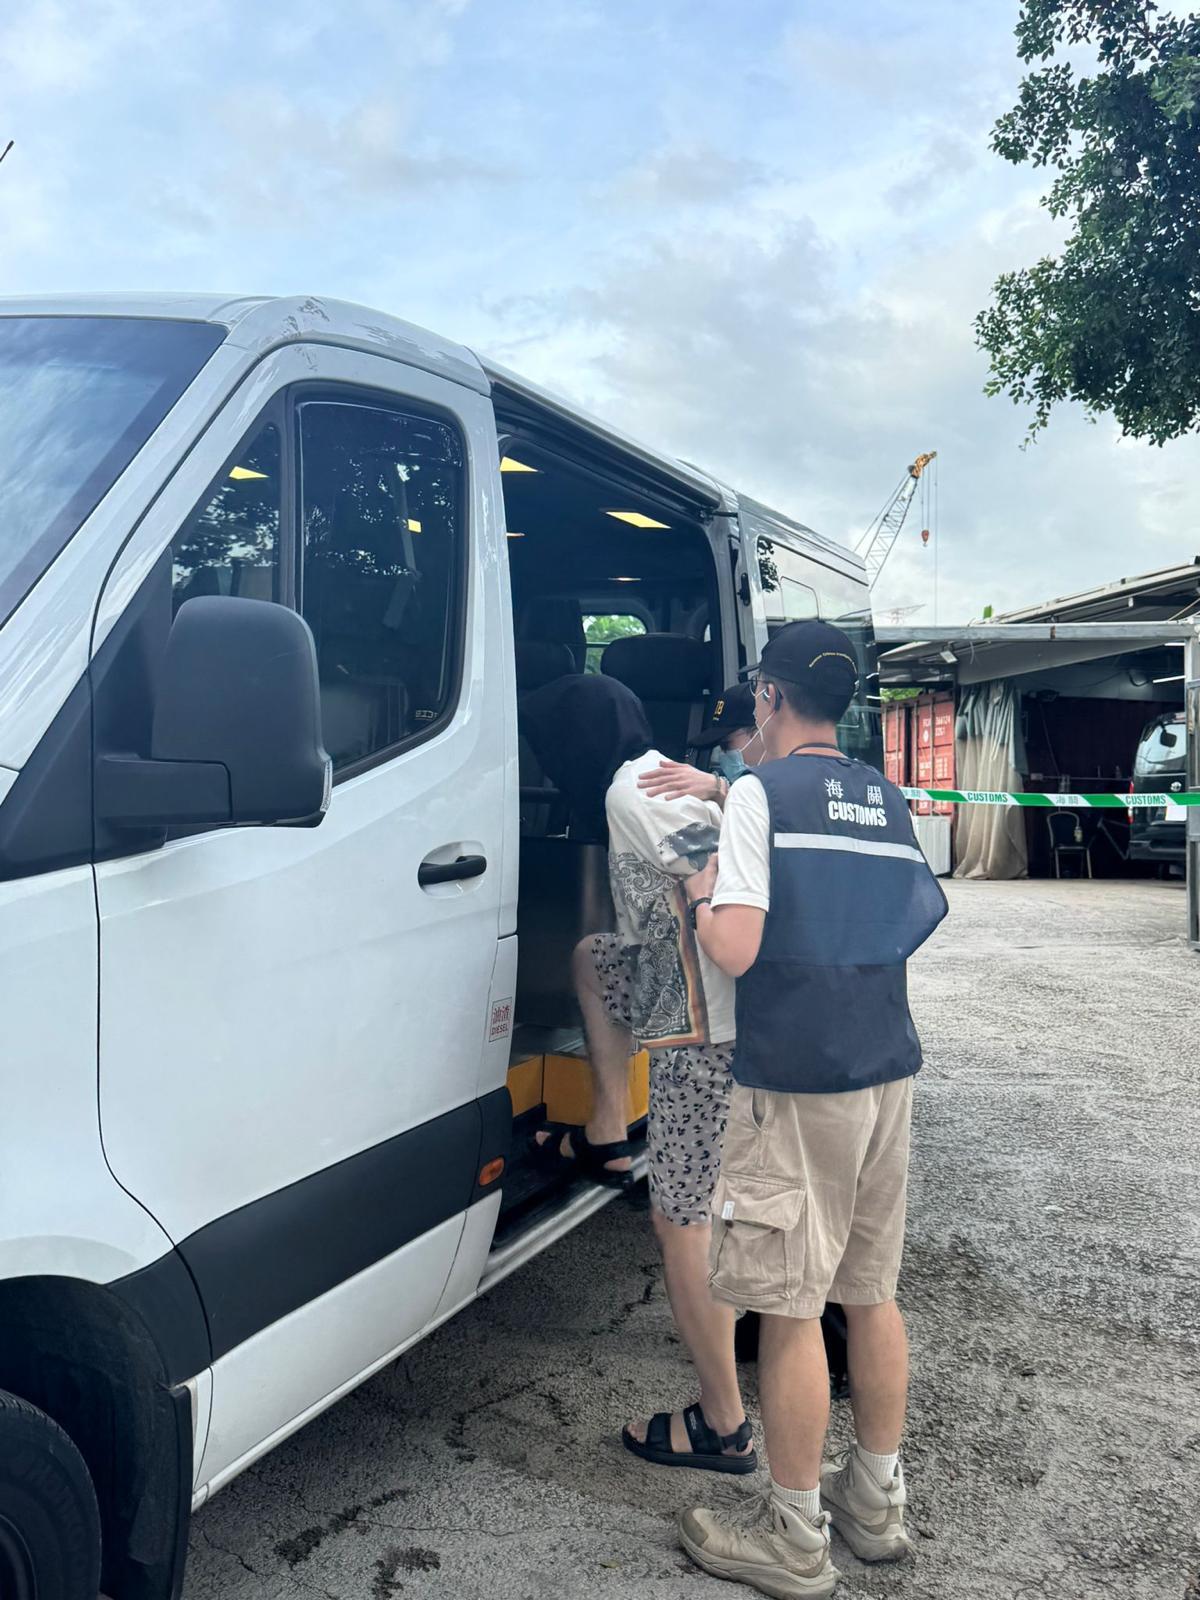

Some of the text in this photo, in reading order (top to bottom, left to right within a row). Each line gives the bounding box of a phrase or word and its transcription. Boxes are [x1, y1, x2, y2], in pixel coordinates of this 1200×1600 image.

[967, 792, 1009, 803] CUSTOMS
[1125, 795, 1167, 805] CUSTOMS
[828, 800, 888, 827] CUSTOMS
